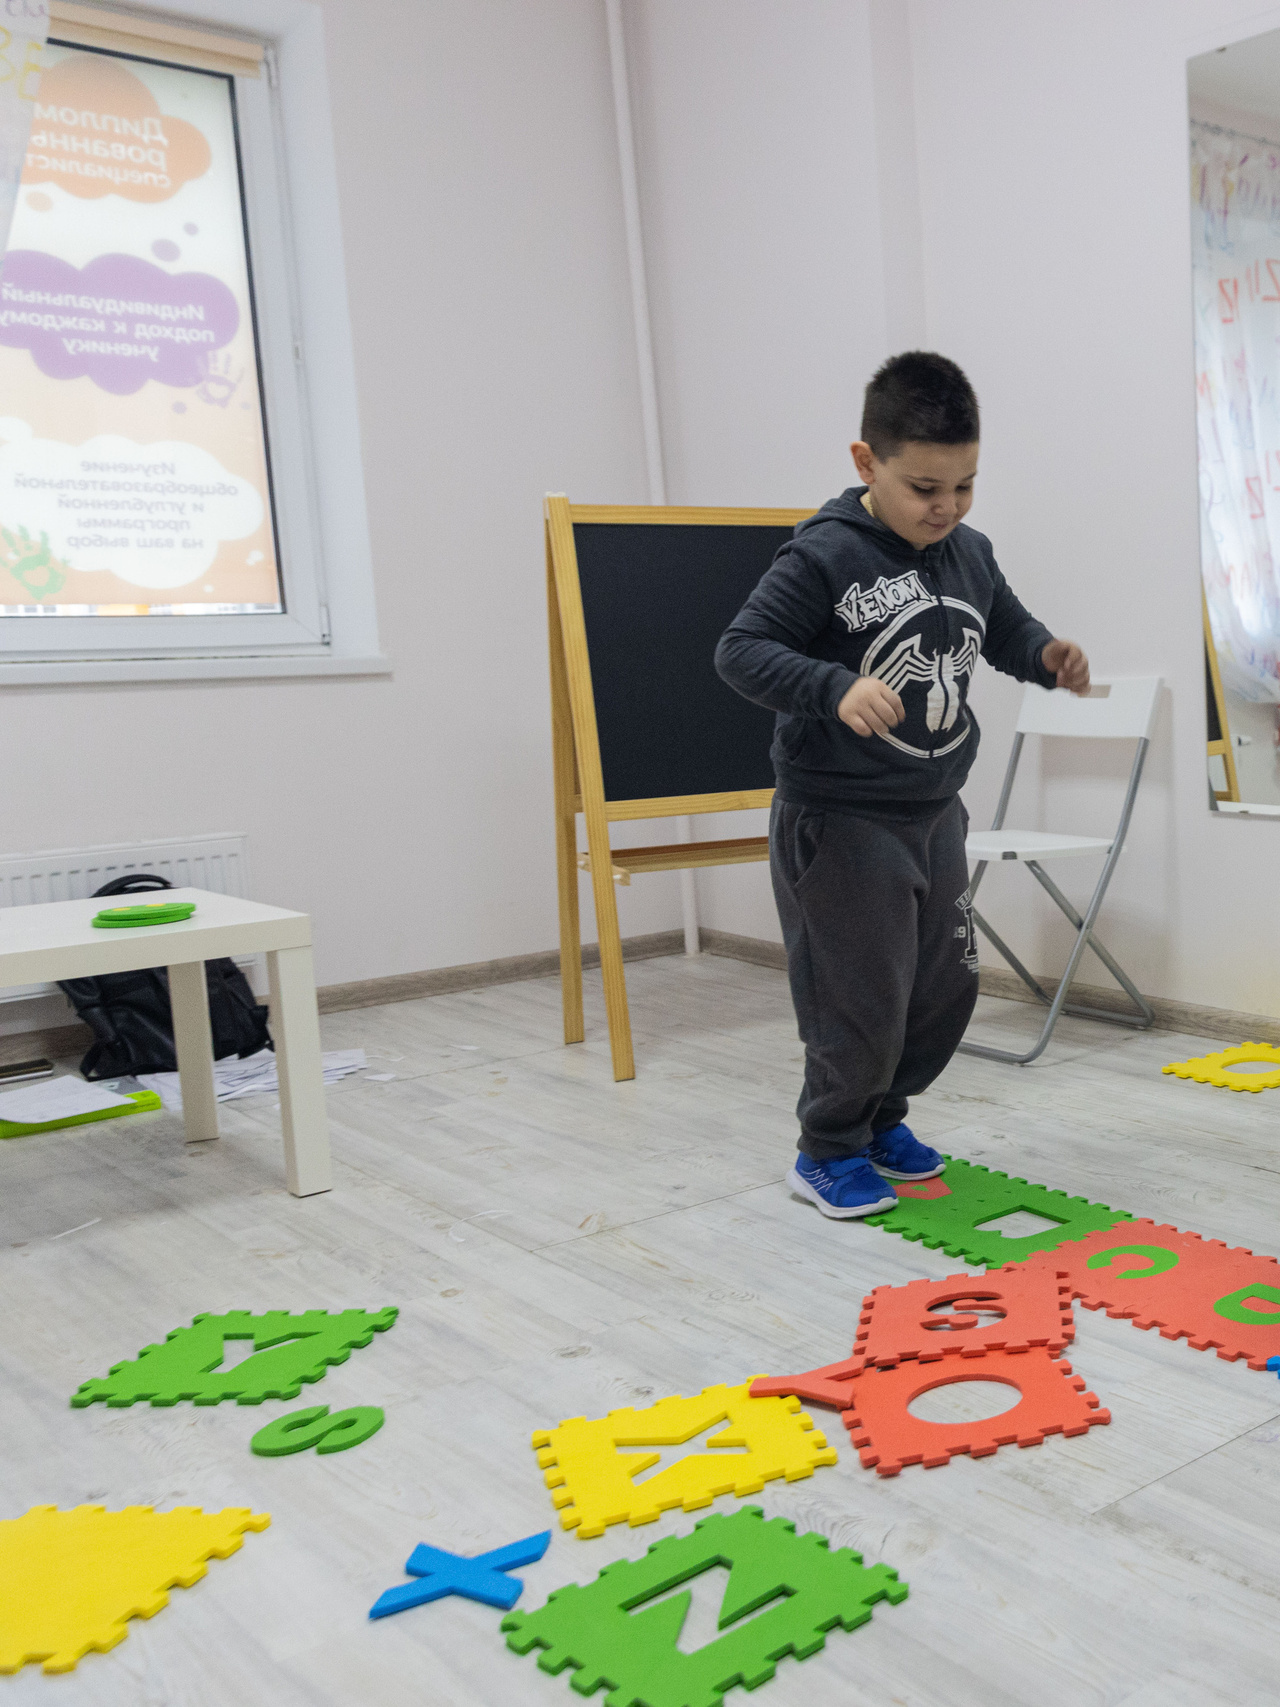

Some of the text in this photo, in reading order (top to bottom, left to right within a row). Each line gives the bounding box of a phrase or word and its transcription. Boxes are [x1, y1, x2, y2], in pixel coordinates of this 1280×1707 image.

[834, 570, 934, 632] VENOM
[1086, 1244, 1180, 1280] C
[368, 1528, 553, 1622] X
